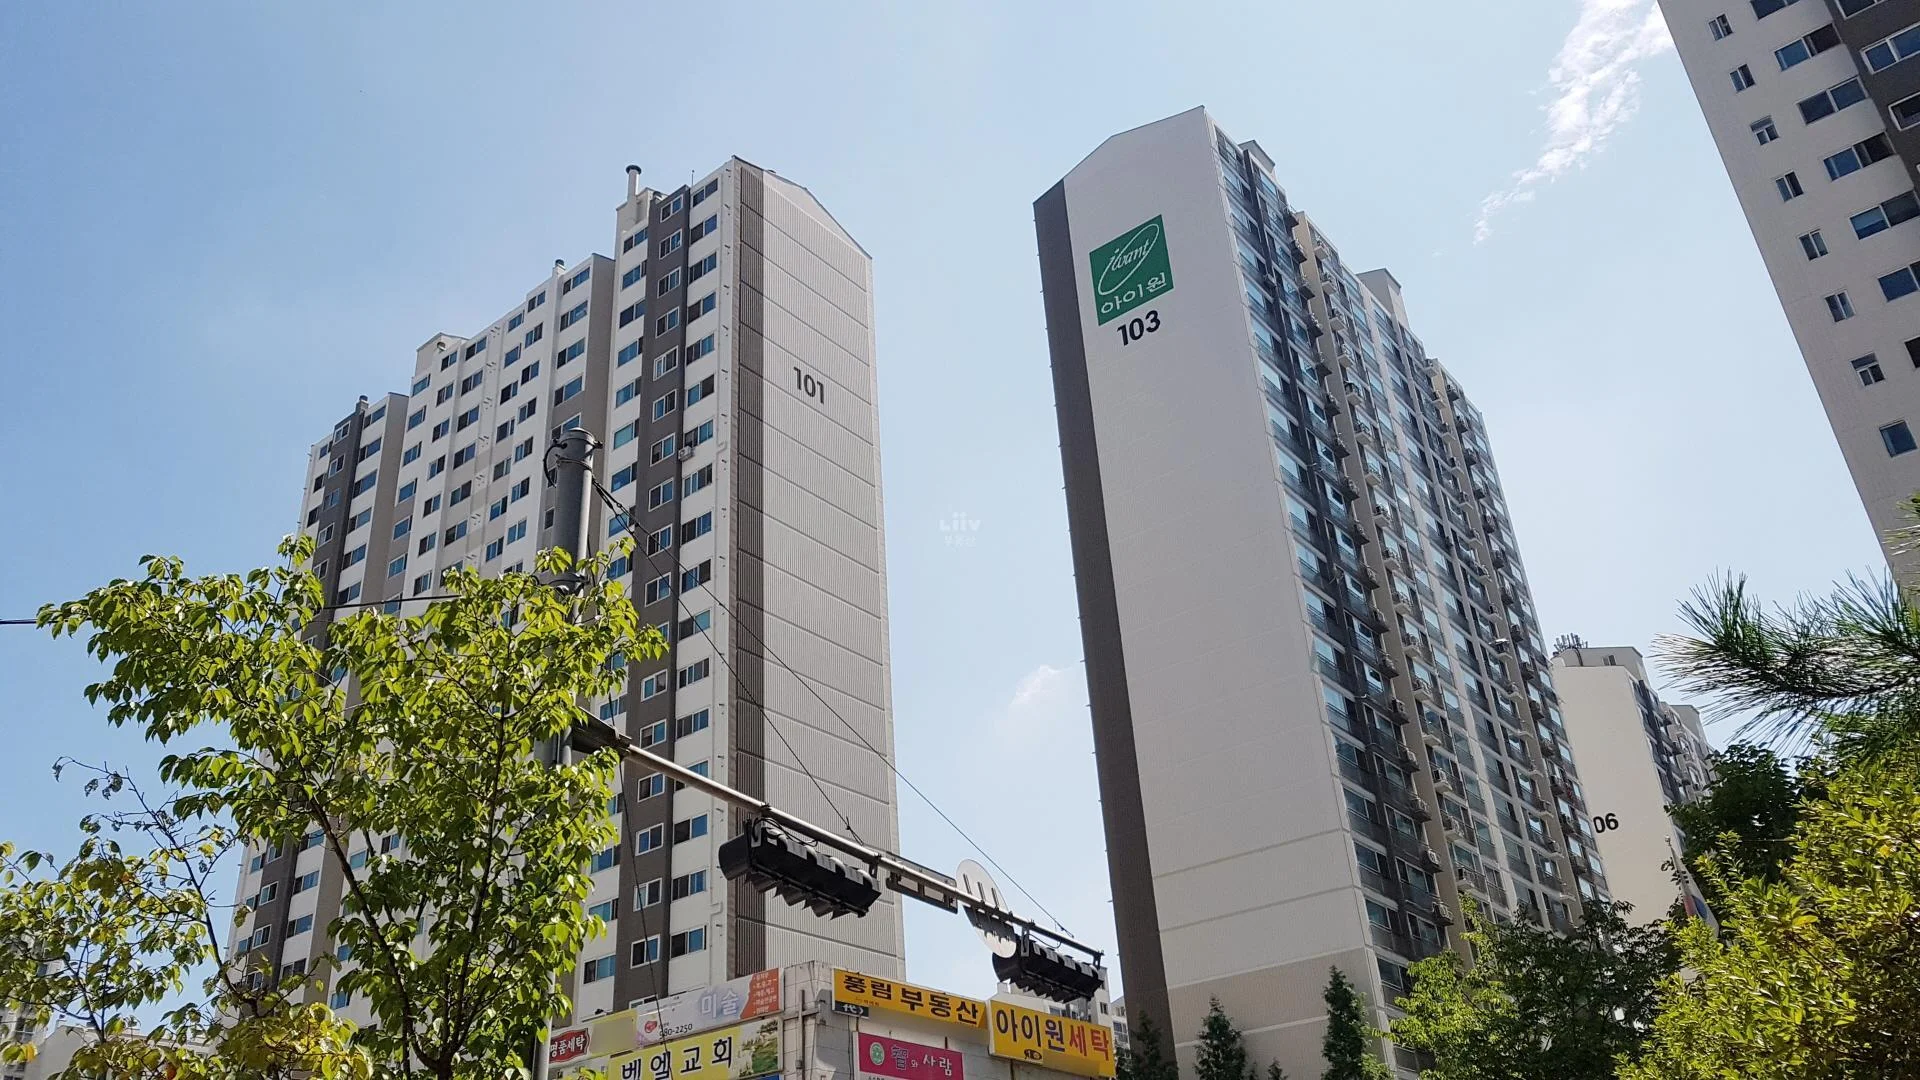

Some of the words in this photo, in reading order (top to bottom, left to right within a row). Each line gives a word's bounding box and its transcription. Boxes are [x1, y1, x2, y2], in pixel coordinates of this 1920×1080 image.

[1100, 272, 1167, 315] 아이원
[1116, 309, 1161, 346] 103
[793, 366, 824, 405] 101
[700, 988, 739, 1020] 미술
[550, 1034, 586, 1058] 명품세탁
[923, 1054, 952, 1076] 사람
